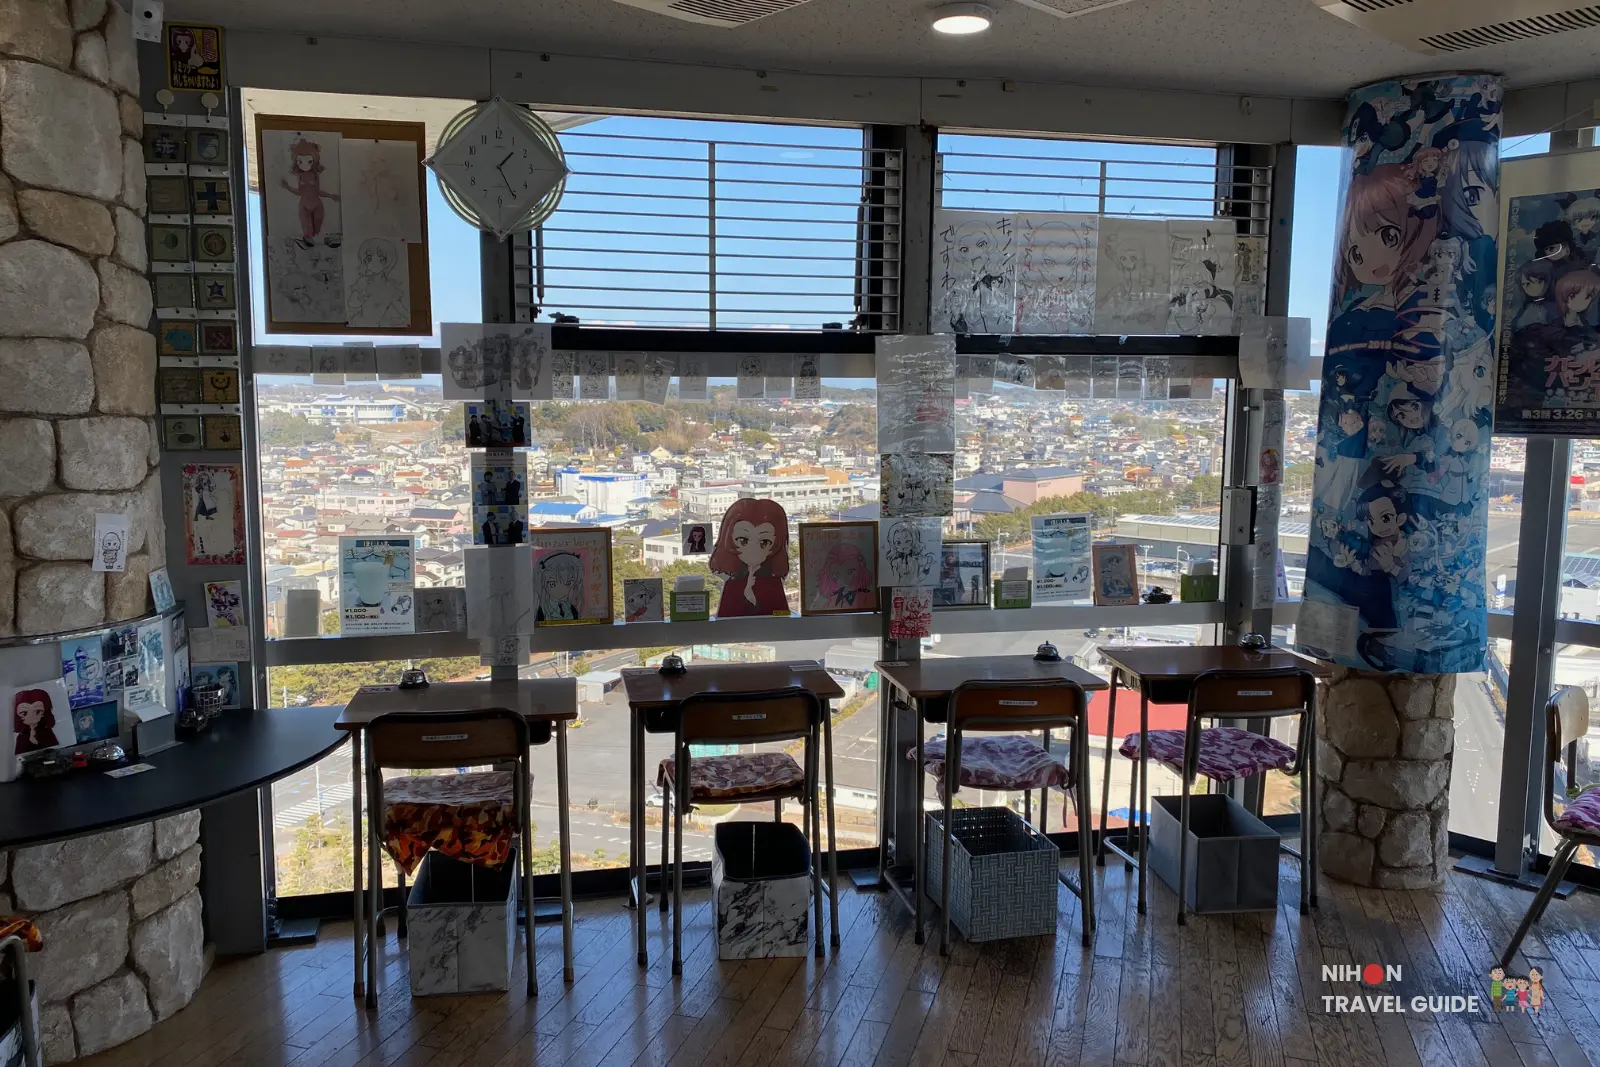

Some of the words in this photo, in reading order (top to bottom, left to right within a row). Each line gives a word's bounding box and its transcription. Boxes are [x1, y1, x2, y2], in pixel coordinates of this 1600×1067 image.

[481, 135, 487, 145] 11
[495, 130, 503, 140] 12
[511, 137, 515, 146] 1
[468, 145, 476, 155] 10
[522, 149, 527, 158] 2
[464, 161, 470, 171] 9
[528, 164, 534, 174] 3
[470, 177, 476, 186] 8
[522, 180, 528, 189] 4
[483, 189, 488, 199] 7
[497, 195, 503, 205] 6
